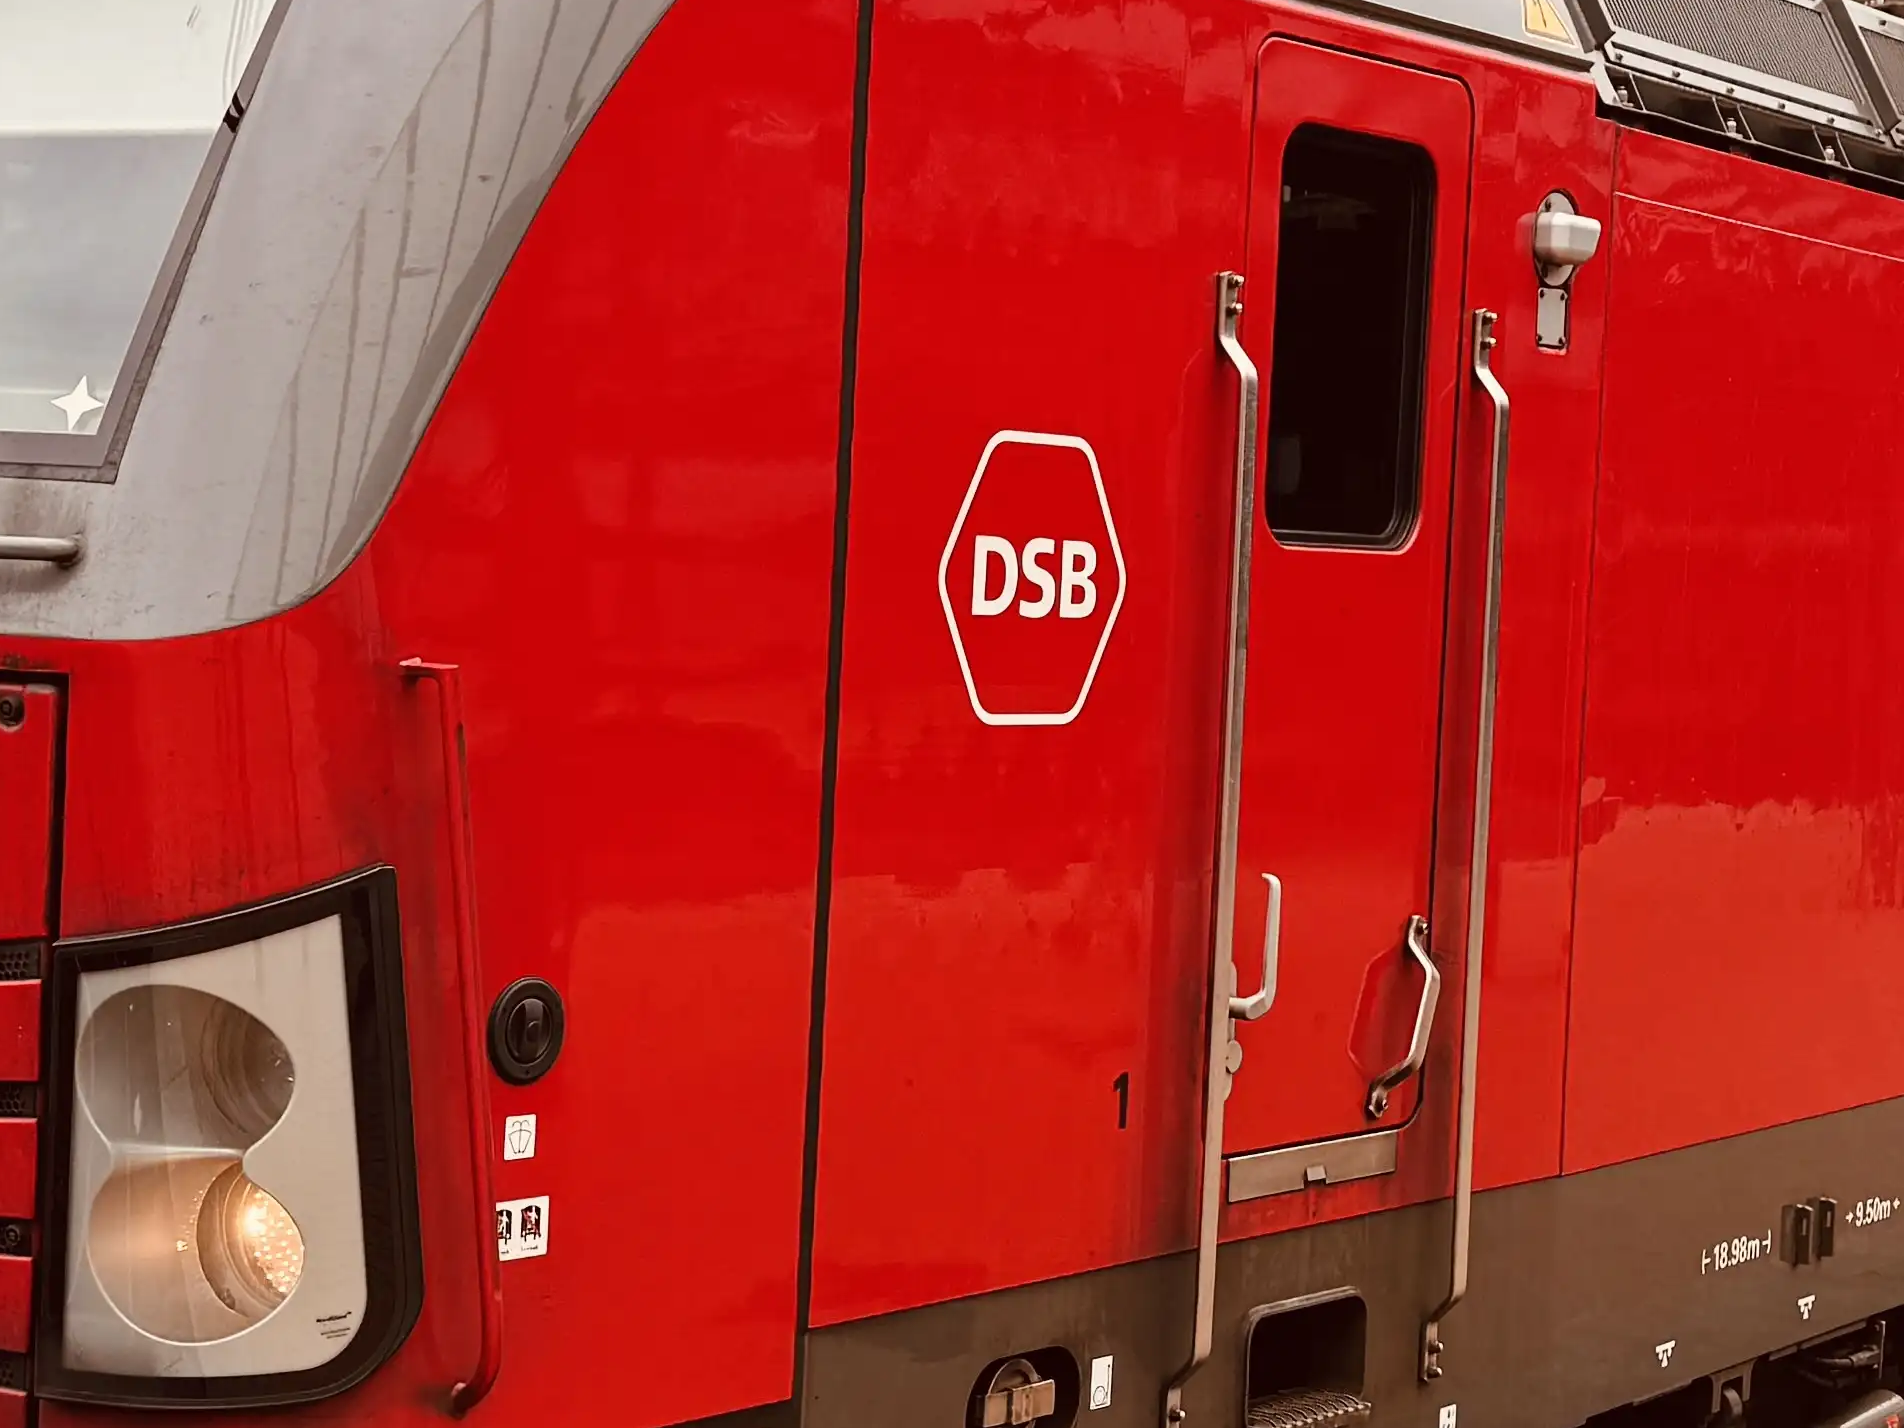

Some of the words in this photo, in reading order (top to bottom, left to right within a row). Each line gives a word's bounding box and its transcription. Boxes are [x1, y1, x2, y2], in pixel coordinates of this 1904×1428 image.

[971, 534, 1098, 619] DSB
[1113, 1072, 1129, 1129] 1
[1855, 1197, 1891, 1227] 9.50m
[1712, 1235, 1761, 1271] 18.98m
